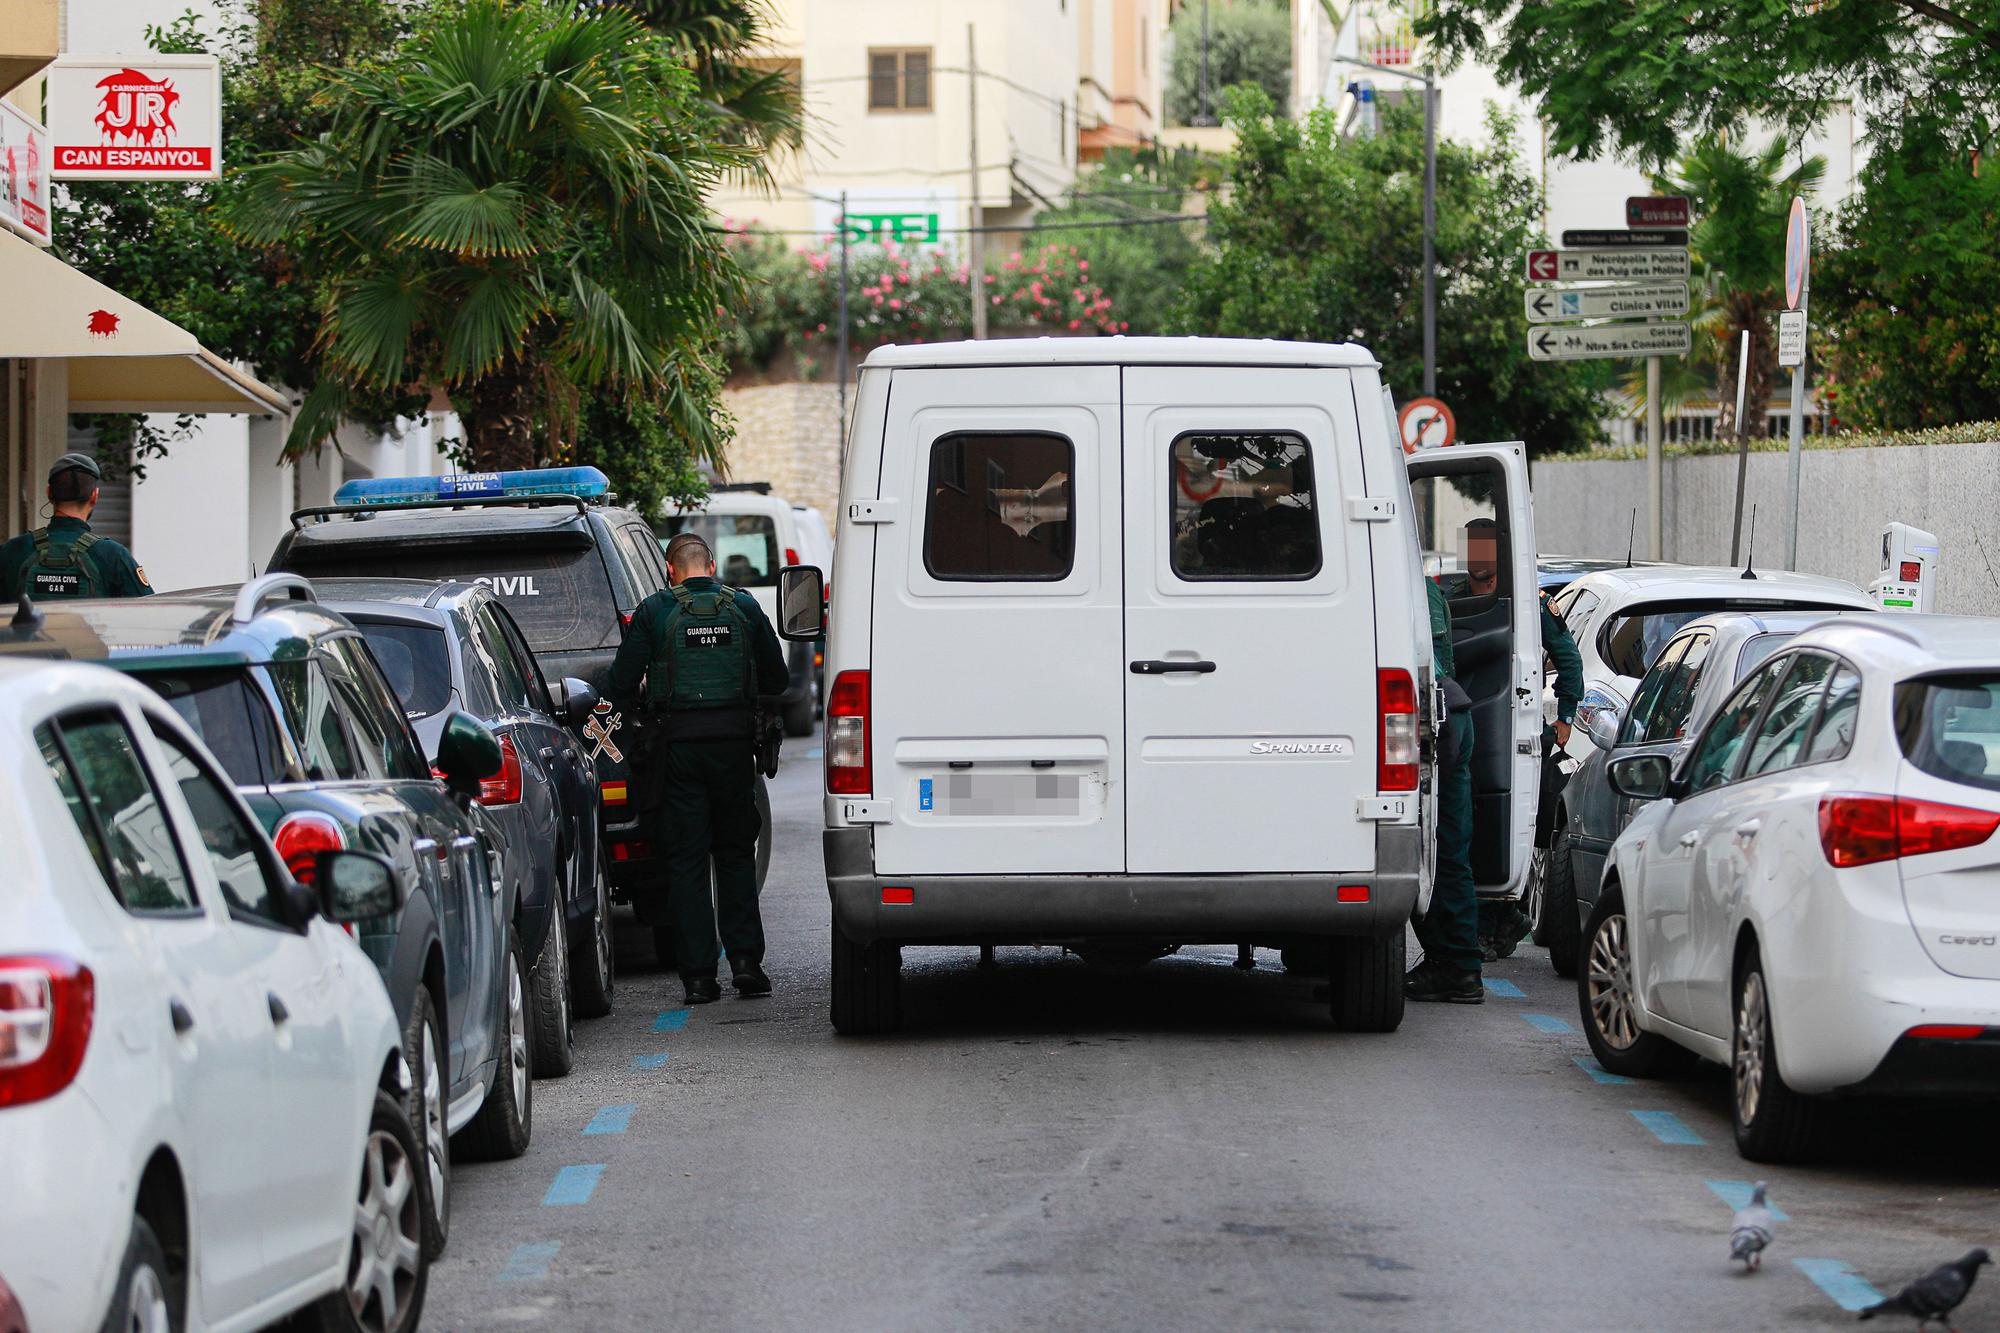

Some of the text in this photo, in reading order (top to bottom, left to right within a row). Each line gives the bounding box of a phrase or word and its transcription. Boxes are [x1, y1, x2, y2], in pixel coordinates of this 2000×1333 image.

[111, 84, 165, 92] CARNICERÍA
[105, 92, 166, 128] JR
[61, 149, 204, 166] CAN ESPANYOL
[442, 473, 498, 484] GUARDIA
[36, 575, 62, 583] GUARDIA
[686, 626, 729, 635] GUARDIA CIVIL
